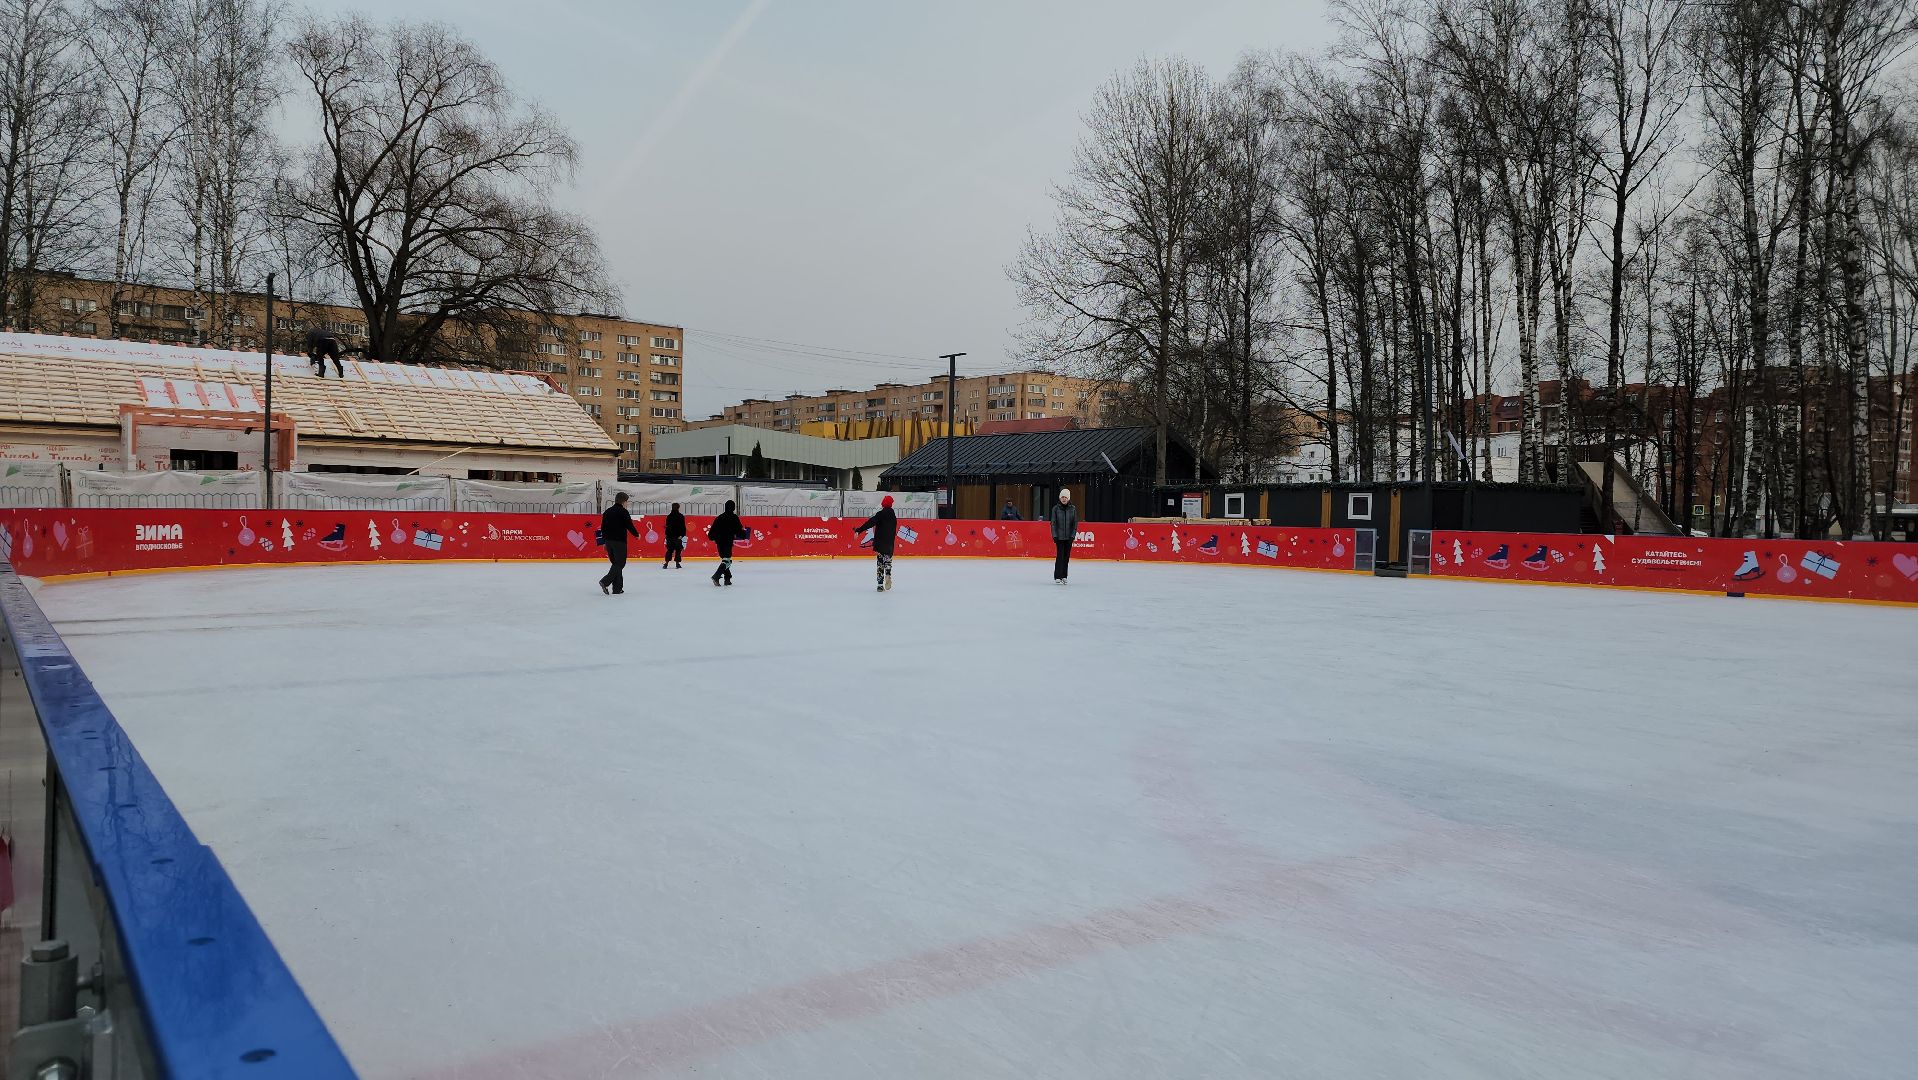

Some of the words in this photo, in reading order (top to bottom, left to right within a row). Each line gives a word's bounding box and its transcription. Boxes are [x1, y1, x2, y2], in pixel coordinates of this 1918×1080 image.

[135, 524, 183, 541] ЗИМА
[1074, 531, 1095, 542] МА
[1645, 550, 1687, 558] КАТАЙТЕСЬ
